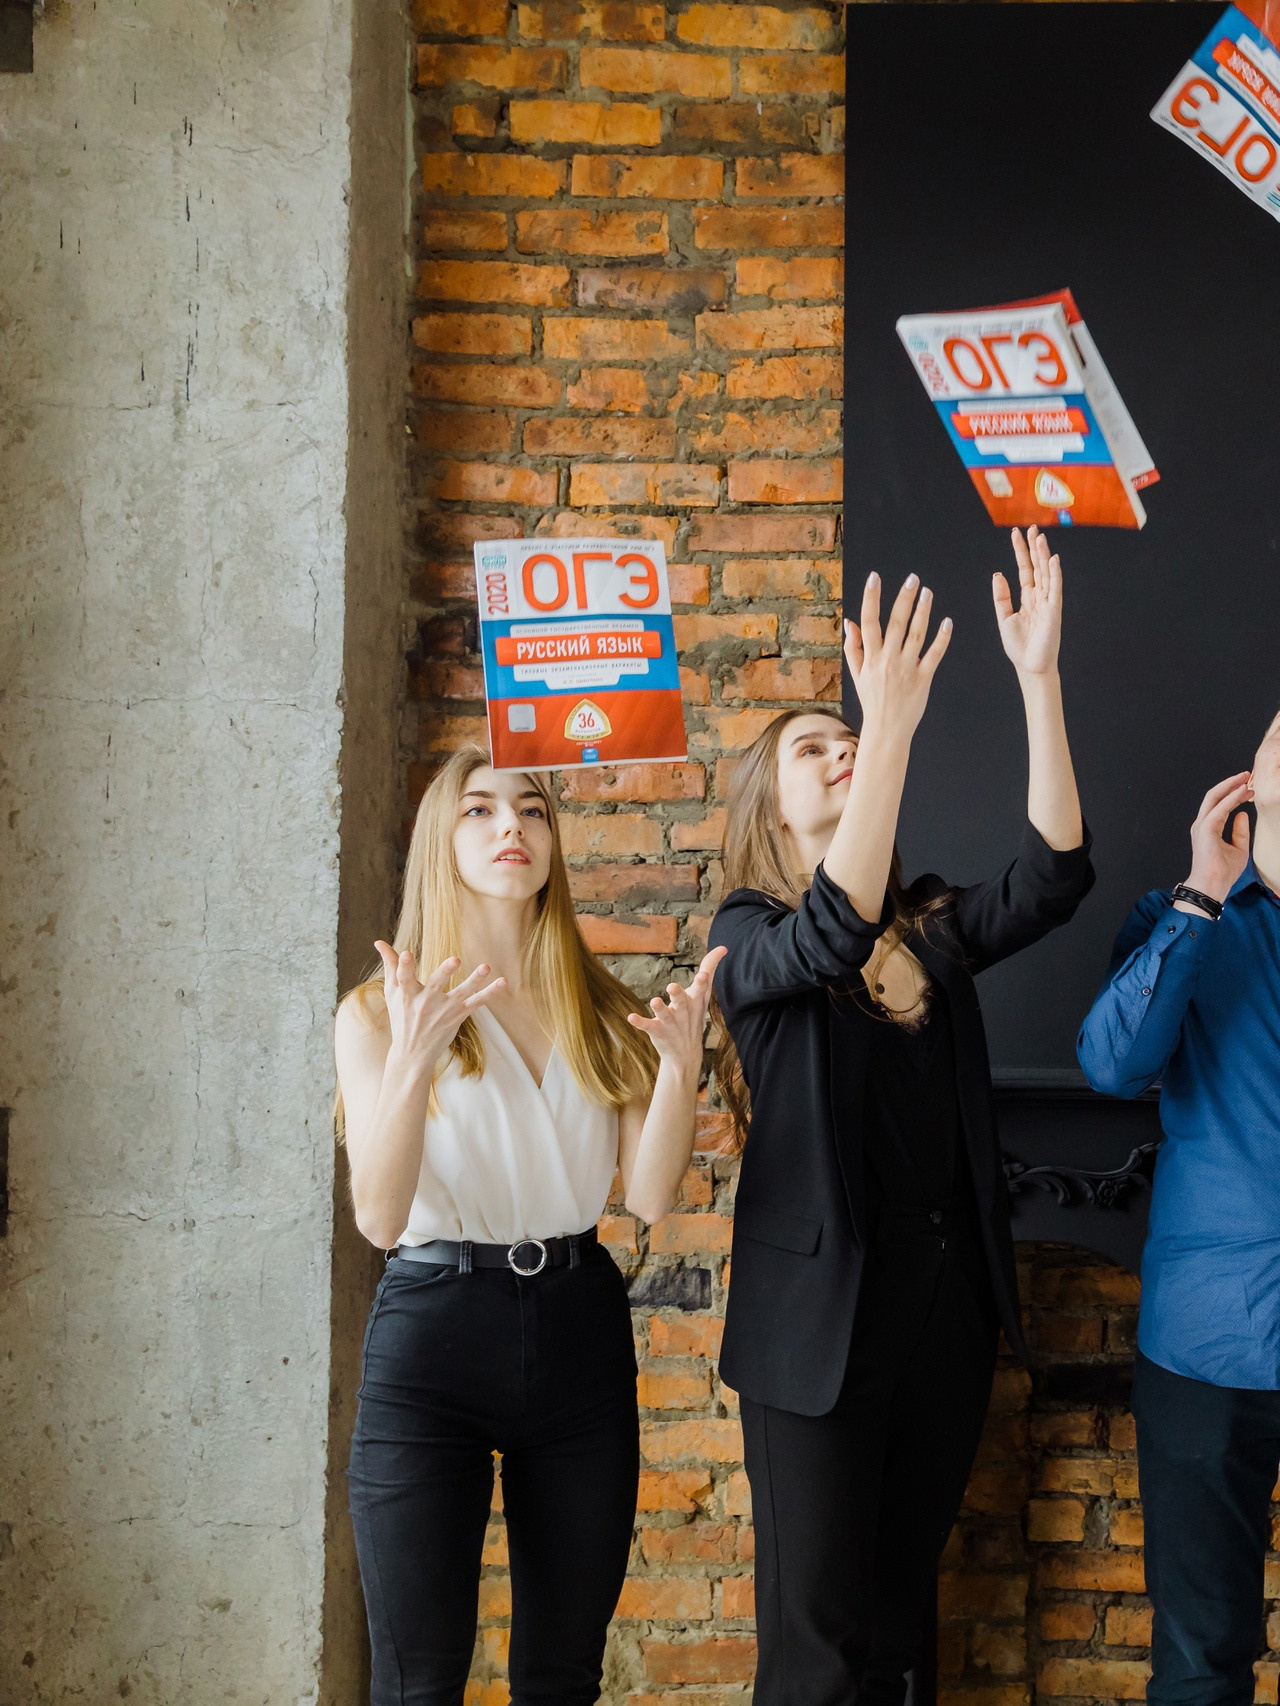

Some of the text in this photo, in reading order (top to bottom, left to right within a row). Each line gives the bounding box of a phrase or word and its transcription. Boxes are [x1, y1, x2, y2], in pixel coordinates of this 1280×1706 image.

[1170, 77, 1278, 183] ОГЭ
[943, 331, 1068, 391] ОГЭ
[485, 572, 509, 615] 2020
[522, 551, 660, 612] ОГЭ
[516, 634, 643, 660] РУССКИЙ ЯЗЫК
[577, 712, 595, 728] 36
